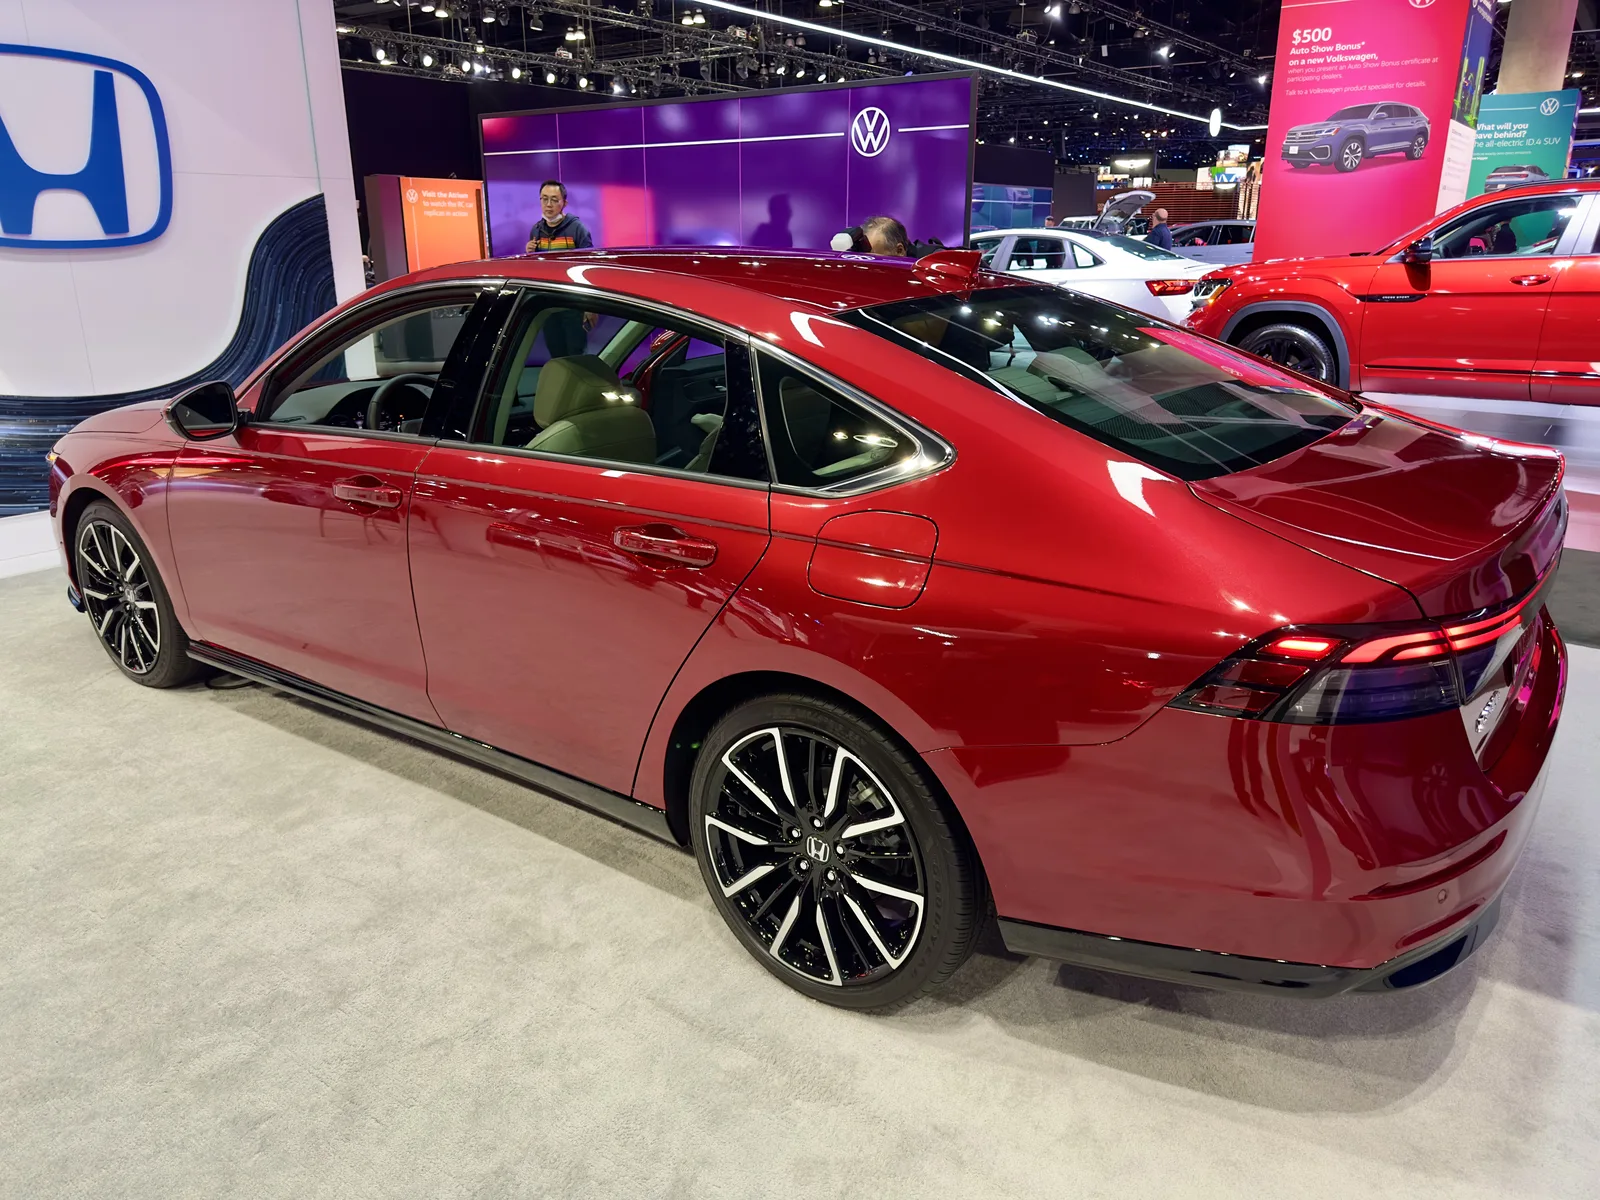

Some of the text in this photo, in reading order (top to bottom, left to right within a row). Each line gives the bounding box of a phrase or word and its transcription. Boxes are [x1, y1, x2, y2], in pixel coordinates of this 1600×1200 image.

[1291, 27, 1332, 46] $500
[1289, 47, 1310, 55] Auto
[1311, 45, 1334, 53] Show
[1307, 57, 1325, 65] new
[1326, 52, 1379, 63] Volkswagen,
[1305, 67, 1315, 75] you
[1316, 65, 1338, 74] present
[1362, 61, 1380, 69] Show
[1401, 57, 1431, 66] certificate
[1287, 74, 1320, 83] participating
[1309, 86, 1343, 95] Volkswagen
[1343, 84, 1367, 93] product
[1368, 82, 1395, 91] specialist
[1496, 122, 1512, 130] will
[1512, 123, 1529, 131] you
[1493, 130, 1527, 139] behind?
[1485, 139, 1524, 148] all-electric
[1525, 138, 1542, 146] ID.4
[1543, 137, 1561, 145] SUV
[421, 190, 437, 198] Visit
[448, 191, 469, 199] Atrium
